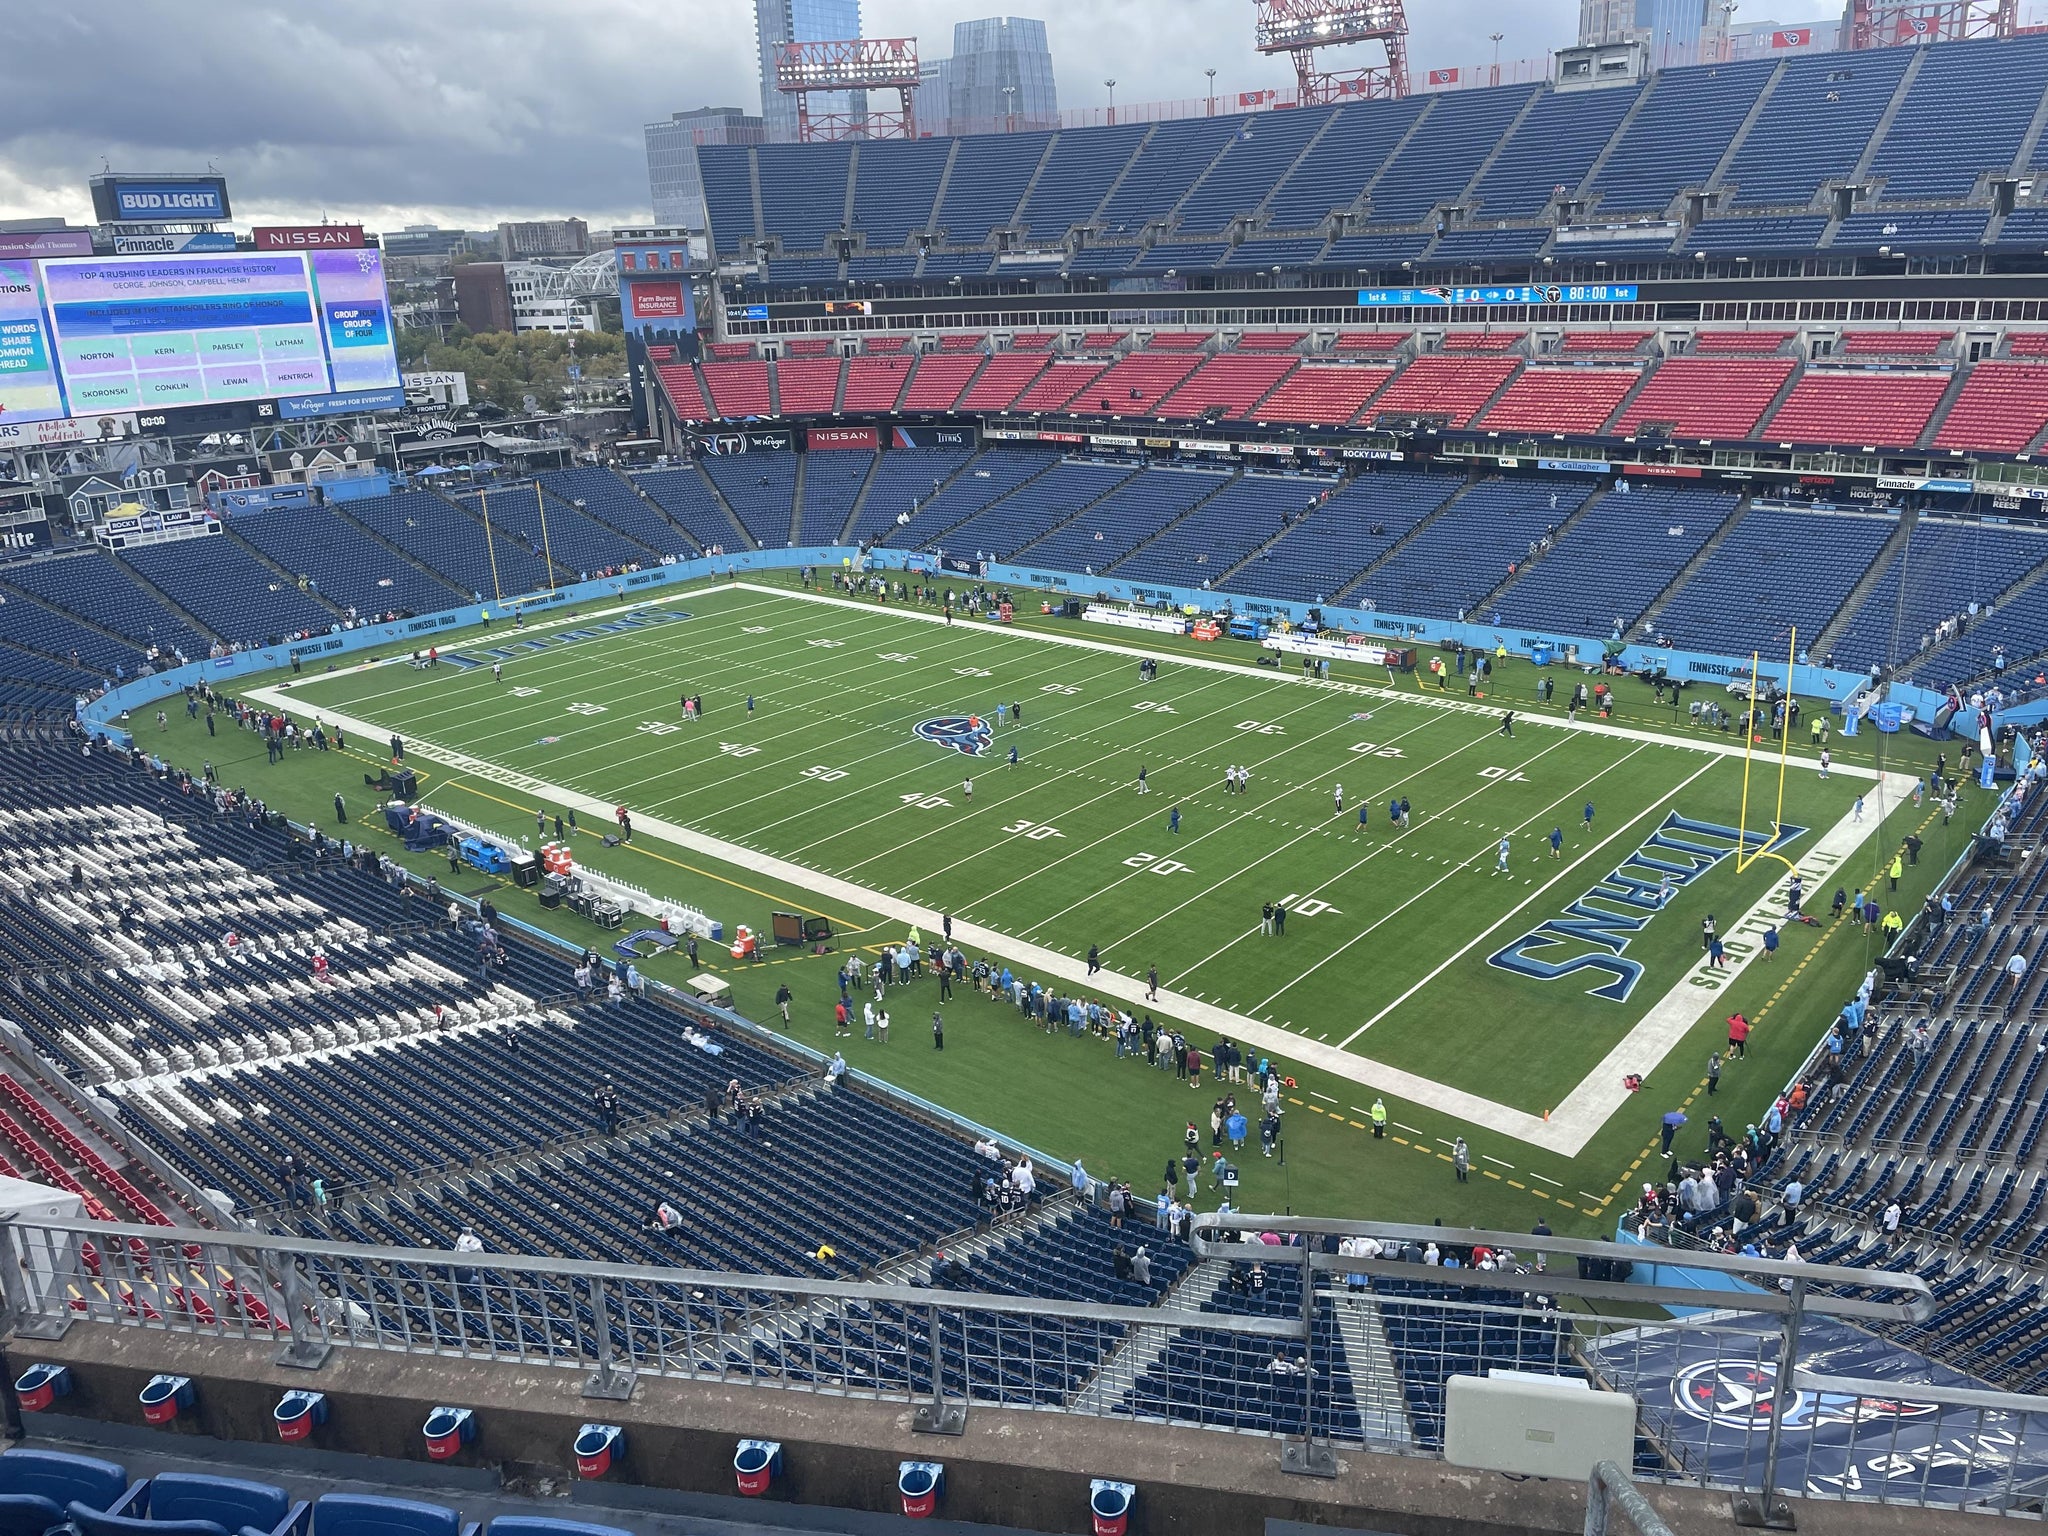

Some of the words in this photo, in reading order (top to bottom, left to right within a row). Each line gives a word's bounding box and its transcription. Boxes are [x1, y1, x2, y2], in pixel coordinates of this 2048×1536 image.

[122, 194, 162, 208] BUD
[164, 193, 215, 208] LIGHT
[269, 231, 351, 244] NISSAN
[25, 241, 45, 249] Saint
[46, 241, 78, 249] Thomas
[118, 237, 175, 252] Pinnacle
[147, 268, 185, 276] LEADERS
[196, 266, 242, 274] FRANCHISE
[243, 265, 276, 273] HISTORY
[0, 285, 31, 293] TIONS
[113, 282, 146, 290] GEORGE,
[148, 281, 184, 289] JOHNSON,
[187, 278, 227, 287] CAMPBELL,
[227, 277, 251, 285] HENRY
[1369, 293, 1380, 301] 1st
[1471, 290, 1479, 301] 0
[1506, 289, 1514, 300] 0
[1569, 287, 1607, 299] 80:00
[1614, 288, 1629, 298] 1st
[335, 310, 359, 318] GROUP
[2, 324, 36, 334] WORDS
[343, 320, 372, 328] GROUPS
[2, 336, 32, 346] SHARE
[275, 339, 304, 347] LATHAM
[212, 343, 244, 351] PARSLEY
[80, 352, 115, 361] NORTON
[222, 378, 248, 386] LEWAN
[278, 373, 314, 382] HENTRICH
[402, 375, 455, 387] ISSAN
[82, 388, 129, 398] SKORONSKI
[155, 383, 189, 392] CONKLIN
[260, 406, 271, 415] 25
[301, 400, 325, 412] Kroger
[417, 404, 446, 413] FRONTIER
[140, 416, 165, 427] 80:00
[763, 436, 786, 448] Kroger
[816, 432, 868, 441] NISSAN
[937, 432, 962, 443] TITANS
[1307, 448, 1326, 456] FedEx
[1343, 450, 1369, 459] ROCKY
[1370, 451, 1388, 459] LAW
[1561, 462, 1600, 471] Gallagher
[1799, 476, 1834, 484] verizon
[1878, 479, 1915, 489] Pinnacle
[1992, 501, 2020, 510] REESE
[166, 513, 183, 521] LAW
[112, 520, 136, 529] ROCKY
[651, 571, 666, 583] TOUGH
[408, 619, 437, 633] TENNESSEE
[438, 614, 456, 626] TOUGH
[1374, 618, 1404, 632] TENNESSEE
[322, 638, 343, 652] TOUGH
[405, 607, 694, 673] TITANS
[1689, 661, 1730, 676] TENNESSEE
[511, 686, 542, 697] 10
[573, 702, 608, 716] 20
[643, 721, 682, 735] 30
[724, 743, 762, 758] 40
[800, 766, 850, 782] 50
[899, 792, 943, 809] 40
[1001, 819, 1055, 840] 30
[1810, 851, 1842, 865] IT
[1122, 852, 1183, 876] 20
[1272, 893, 1331, 917] 10
[1487, 809, 1811, 1003] TITANS
[1736, 909, 1786, 936] ALL
[1689, 965, 1732, 990] US
[1254, 1279, 1263, 1287] 12
